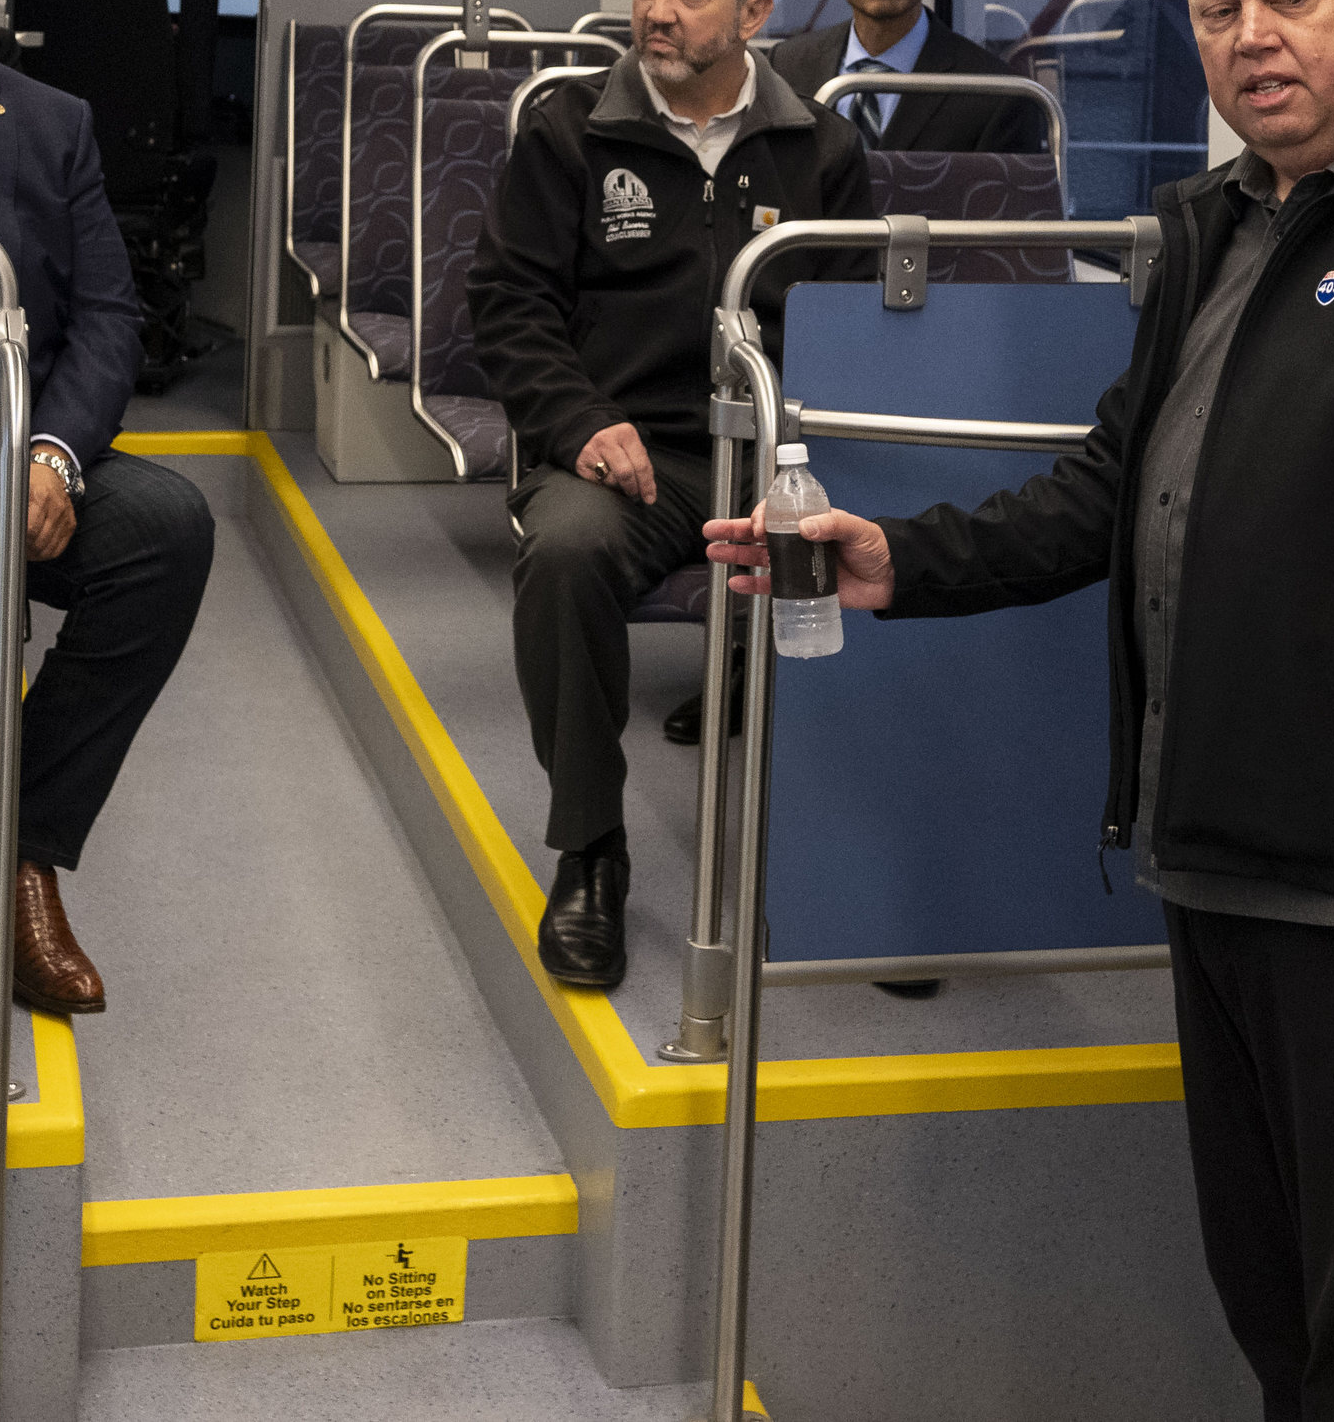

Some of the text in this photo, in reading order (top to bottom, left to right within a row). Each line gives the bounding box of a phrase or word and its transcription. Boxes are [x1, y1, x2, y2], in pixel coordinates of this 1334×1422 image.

[363, 1272, 437, 1287] No Sitting
[241, 1283, 288, 1298] Watch
[366, 1285, 432, 1300] on Steps
[227, 1297, 301, 1312] Your Step
[343, 1297, 454, 1314] No sentarse en
[210, 1313, 315, 1330] Cuida tu paso
[347, 1311, 449, 1328] los escalones
